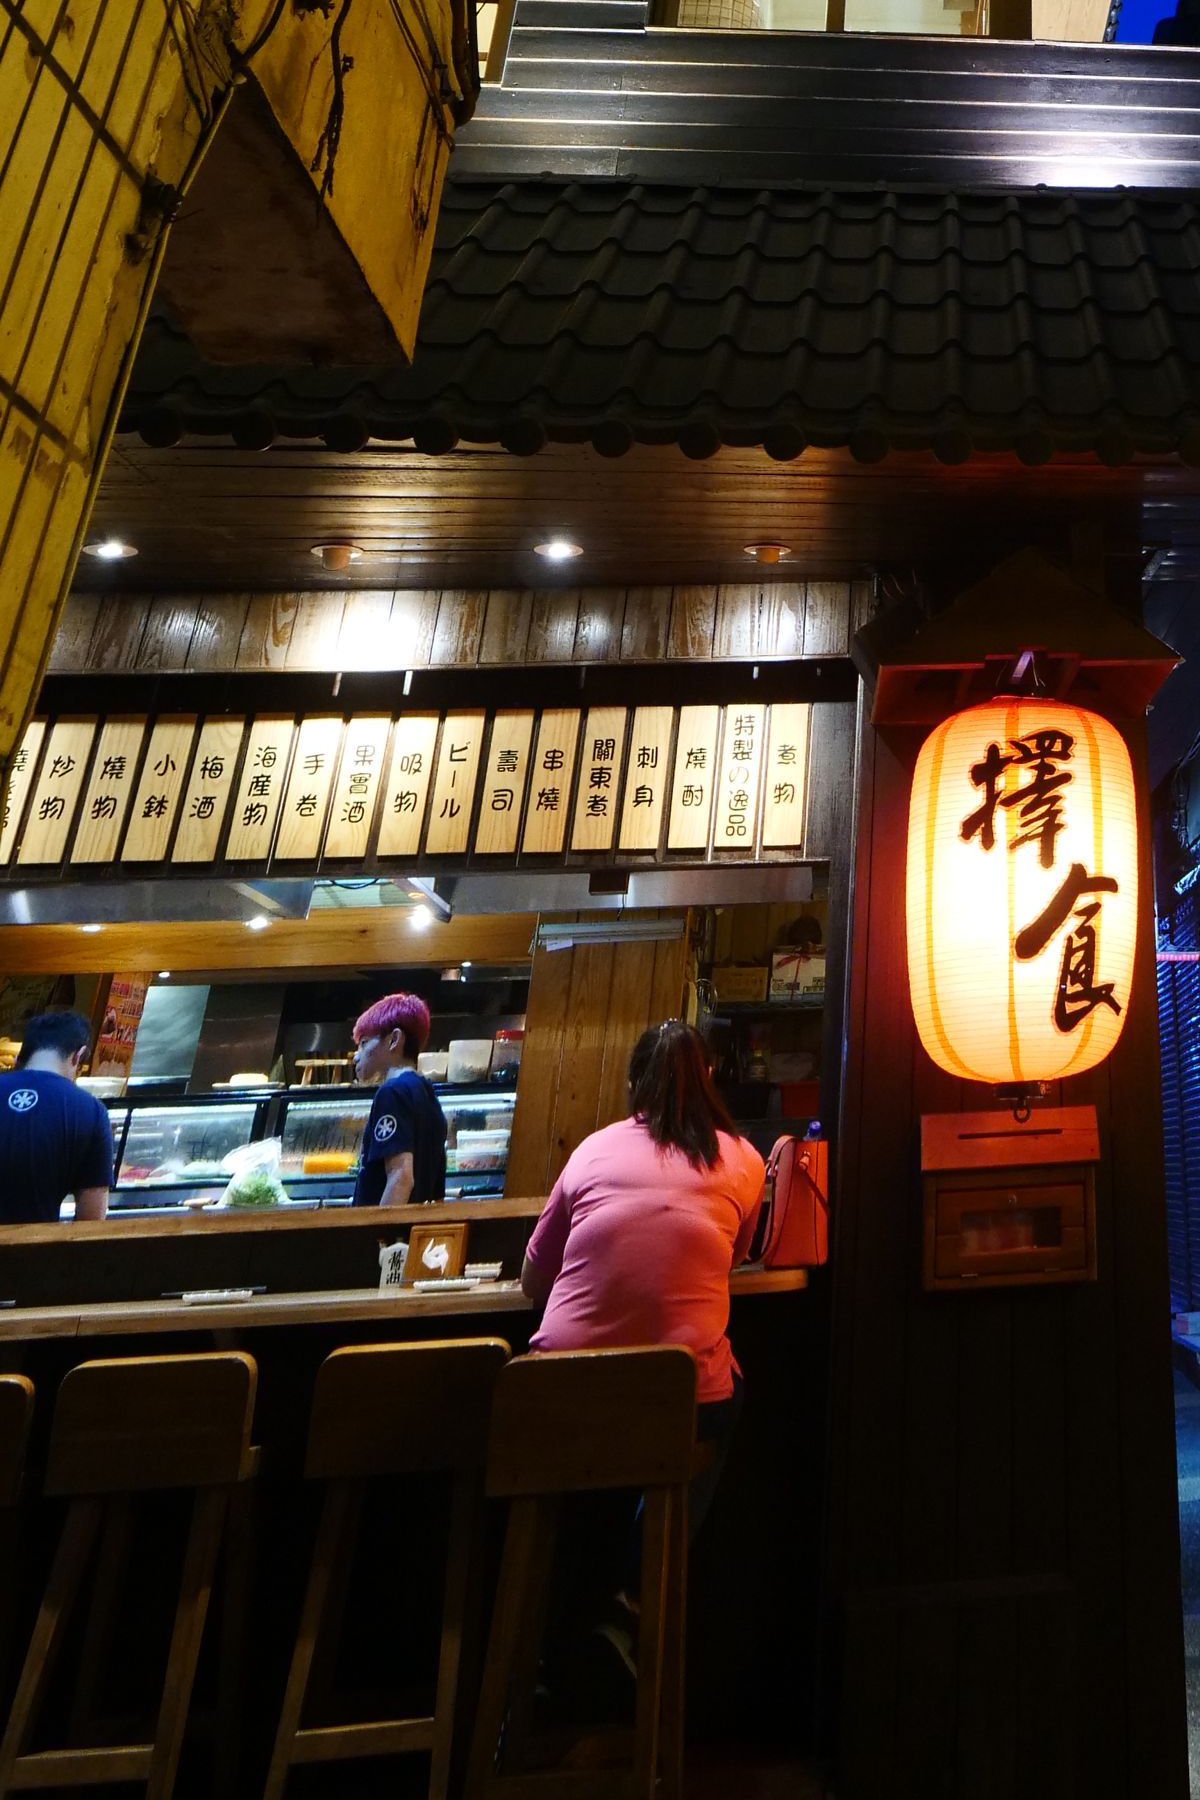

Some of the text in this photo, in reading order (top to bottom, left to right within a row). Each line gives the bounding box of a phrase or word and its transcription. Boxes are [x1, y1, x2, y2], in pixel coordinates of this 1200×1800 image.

[38, 755, 76, 821] 炒物
[91, 755, 127, 820] 燒物
[142, 753, 177, 819] 小鉢
[189, 755, 225, 819] 梅酒
[295, 753, 326, 818] 手卷
[340, 744, 377, 824] 果實酒
[393, 754, 424, 814] 吸物
[439, 741, 471, 819] ビール
[491, 749, 519, 811] 壽司
[535, 749, 565, 811] 串燒
[585, 738, 616, 817] 關東煮
[632, 745, 659, 808] 刺身
[681, 747, 708, 807] 燒酎
[725, 714, 756, 837] 特製の逸品
[773, 743, 798, 804] 煮物
[960, 729, 1121, 1033] 擇食
